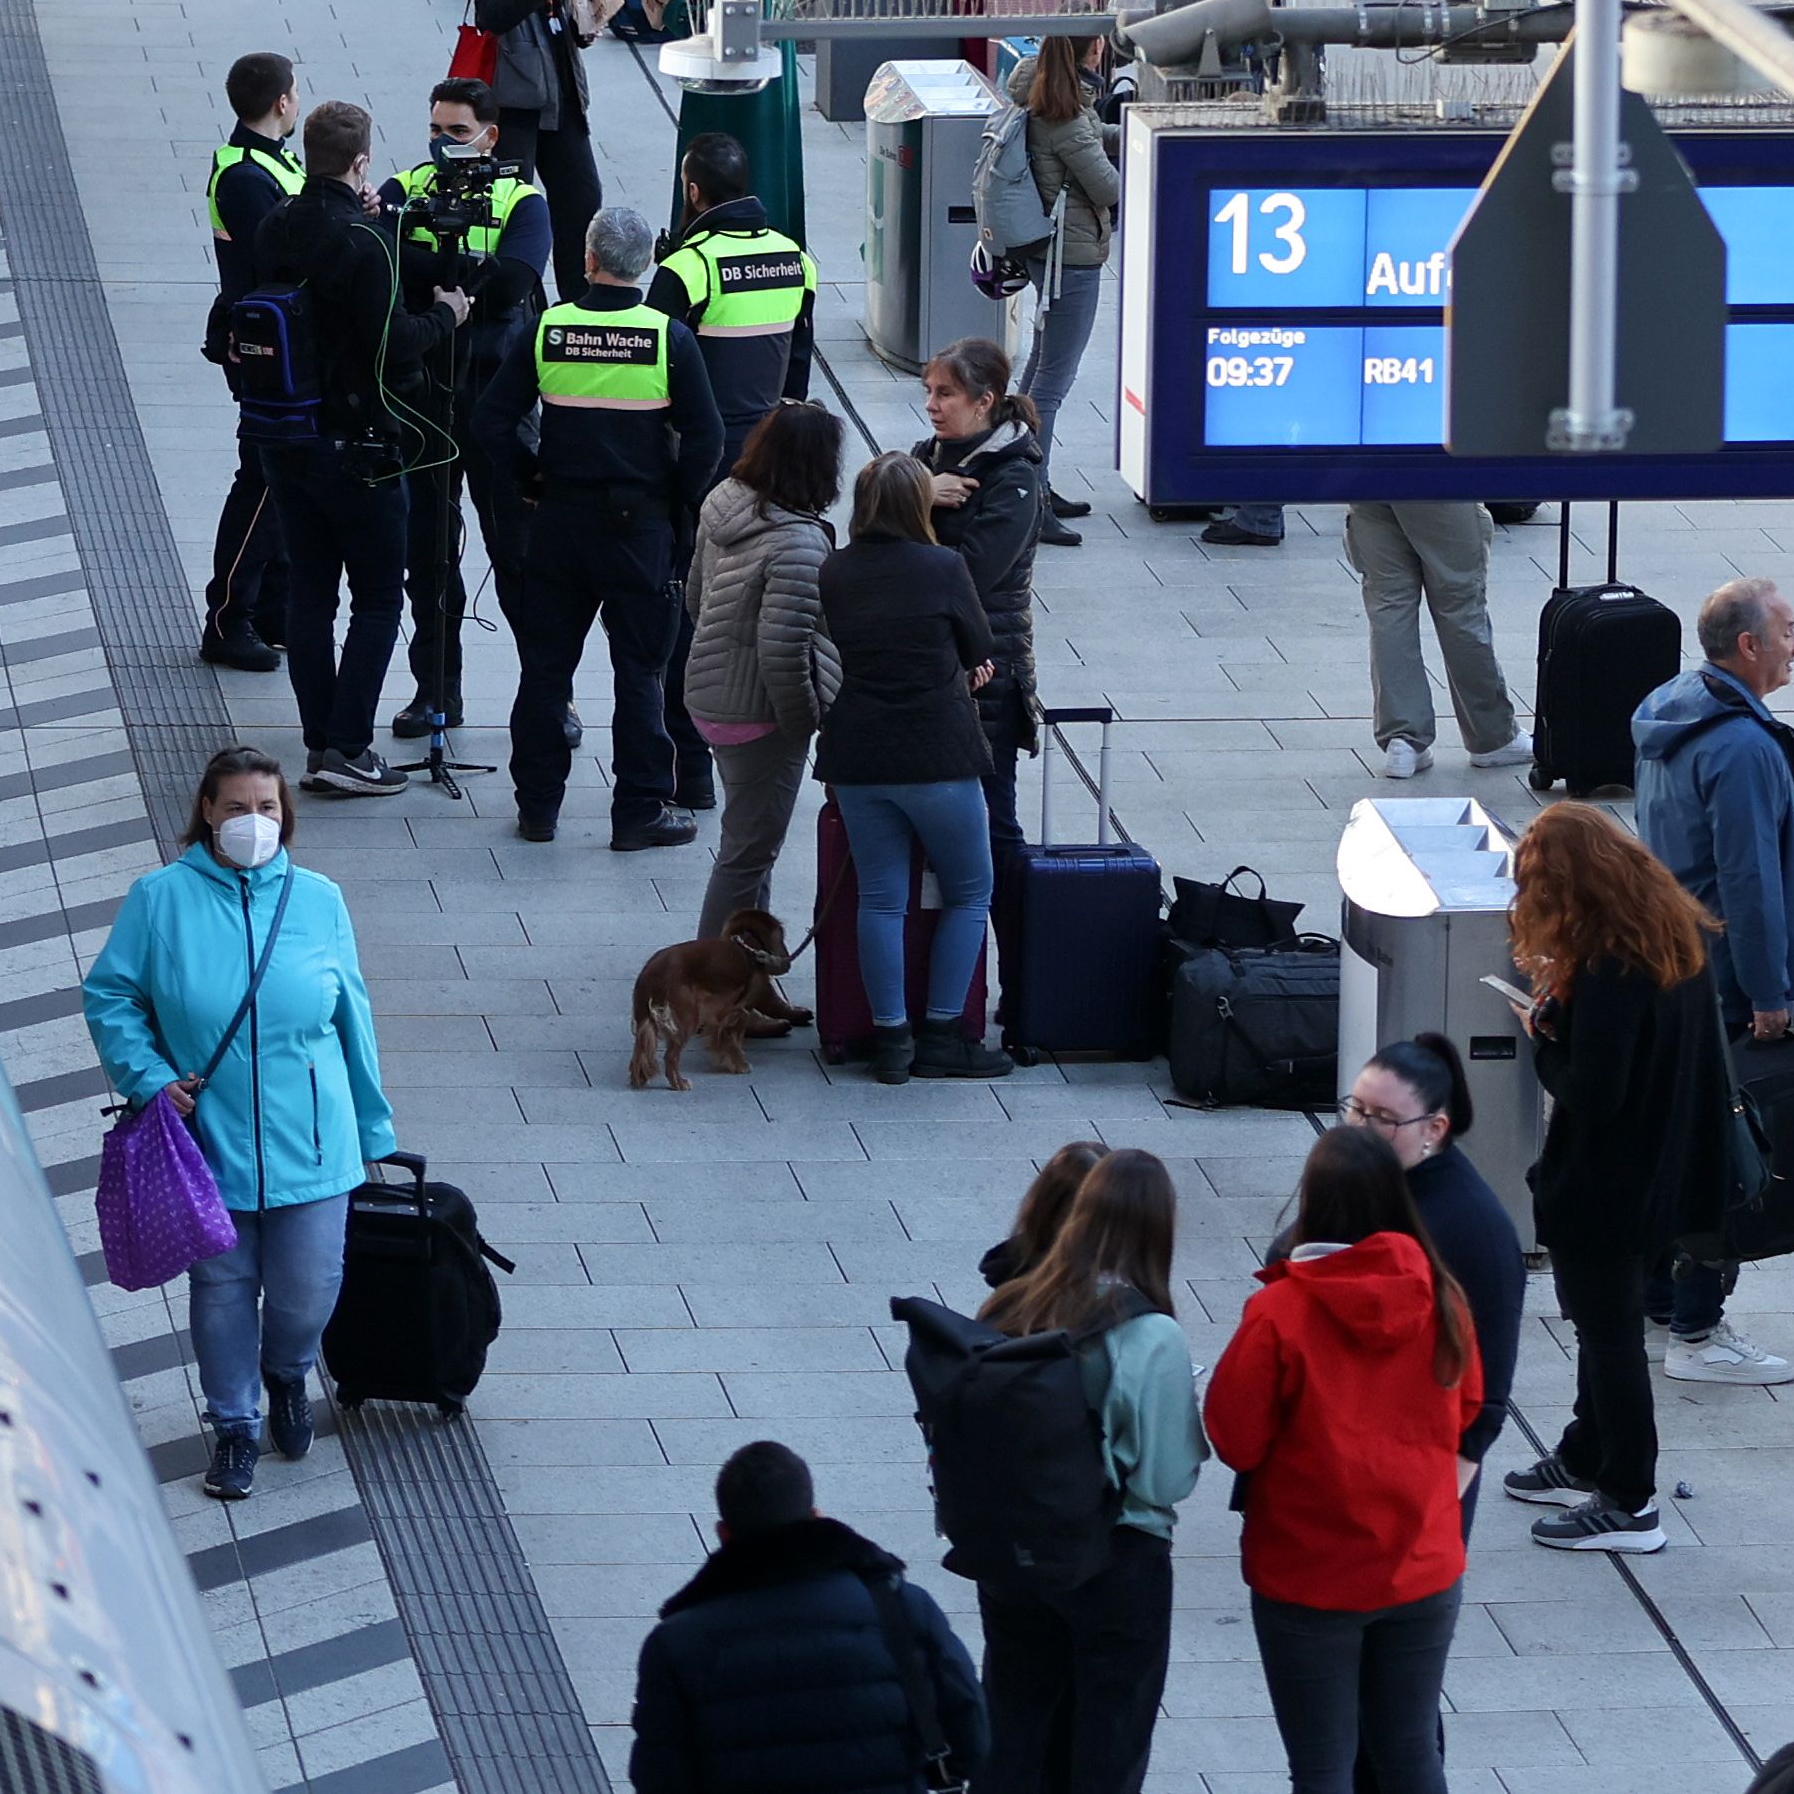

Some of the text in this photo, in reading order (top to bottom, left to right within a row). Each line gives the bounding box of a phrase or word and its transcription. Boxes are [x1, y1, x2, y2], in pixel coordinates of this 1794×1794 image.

[1214, 192, 1307, 274] 13
[721, 260, 803, 283] DB Sicherheit
[1366, 252, 1453, 295] Auf
[566, 332, 603, 347] Bahn
[605, 333, 653, 349] Wache
[1208, 327, 1306, 348] Folgezüge
[565, 346, 632, 359] DB Sicherheit
[1207, 356, 1294, 387] 09:37
[1364, 357, 1434, 384] RB41
